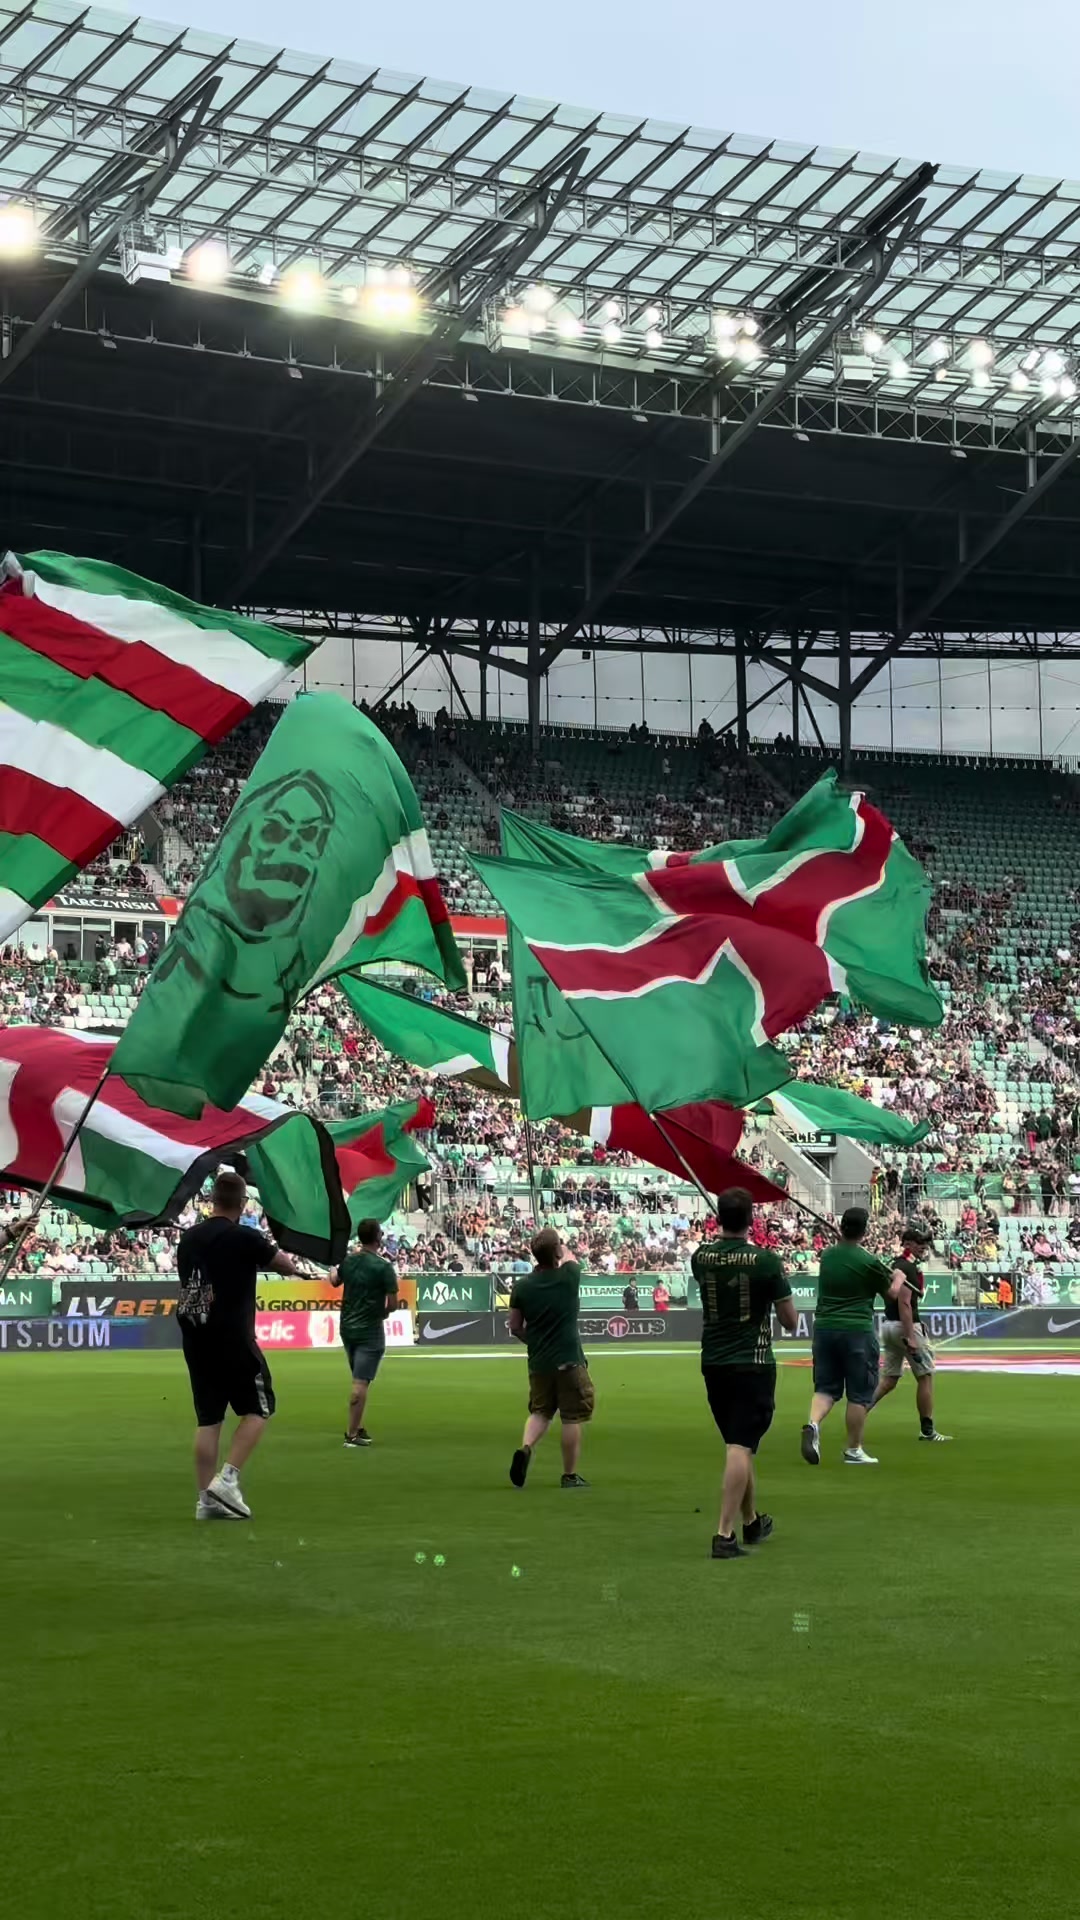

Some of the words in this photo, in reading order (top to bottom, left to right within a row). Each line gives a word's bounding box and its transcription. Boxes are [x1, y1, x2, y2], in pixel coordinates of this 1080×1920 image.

[56, 895, 159, 911] TARCZYŃSKI
[796, 1132, 816, 1143] C15
[791, 1287, 816, 1297] PORT
[268, 1300, 343, 1312] GRODZIS
[256, 1319, 296, 1340] clic
